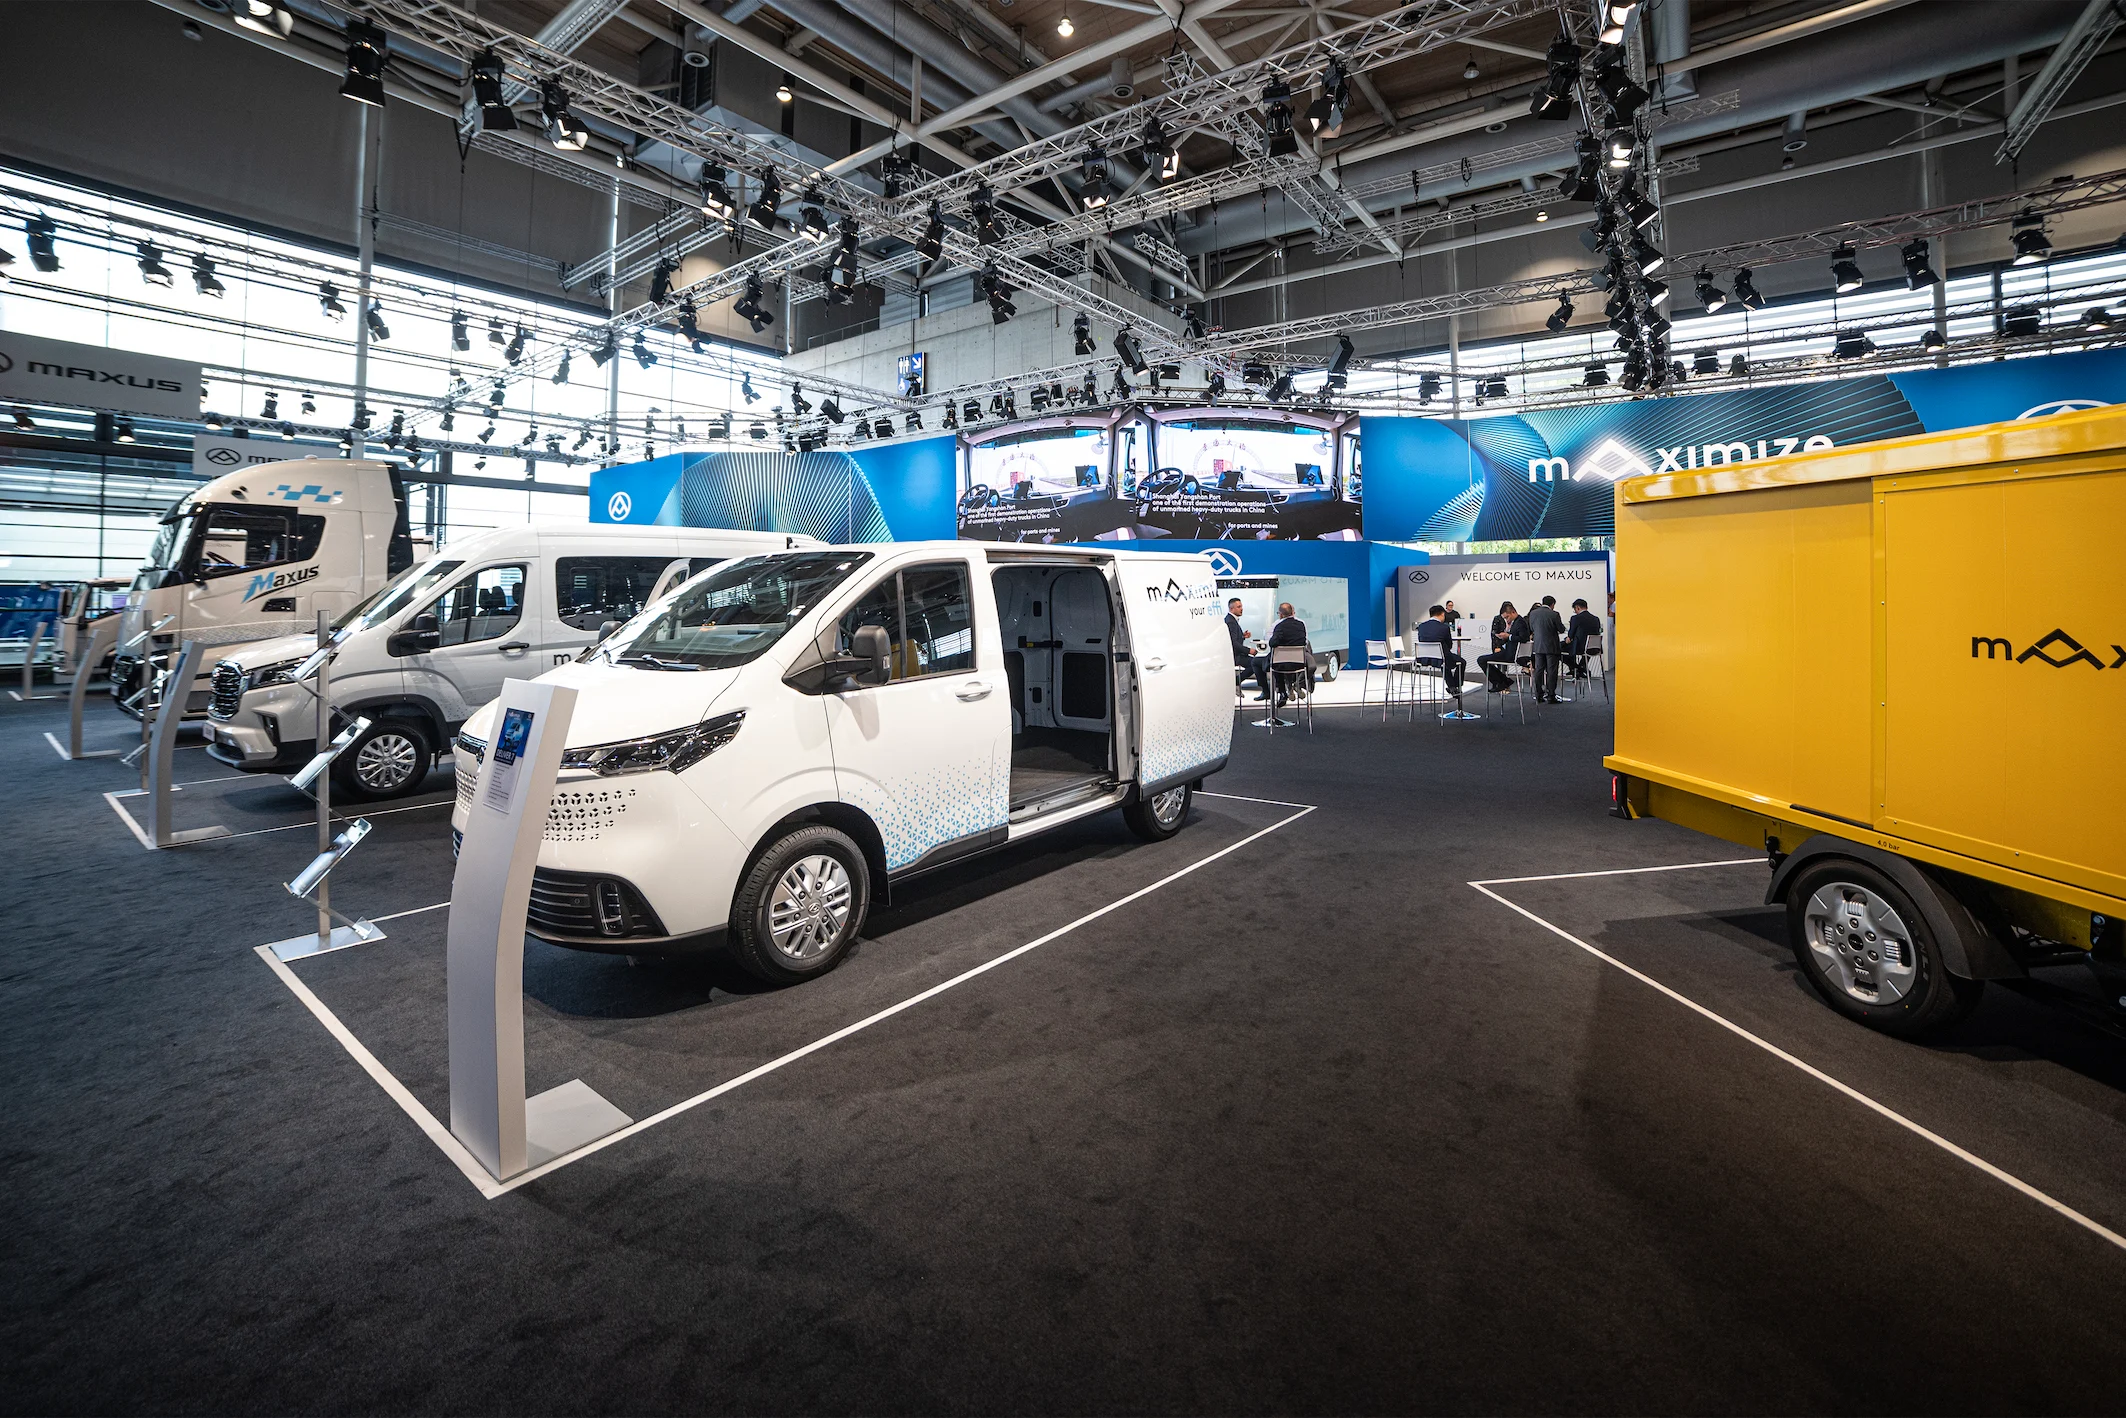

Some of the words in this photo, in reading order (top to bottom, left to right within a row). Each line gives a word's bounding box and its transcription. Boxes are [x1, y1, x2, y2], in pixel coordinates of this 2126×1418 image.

[1460, 571, 1520, 582] WELCOME
[1525, 571, 1541, 581] TO
[1546, 570, 1592, 581] MAXUS
[1189, 607, 1205, 619] your
[1207, 601, 1224, 616] effi
[1888, 843, 1900, 851] bar
